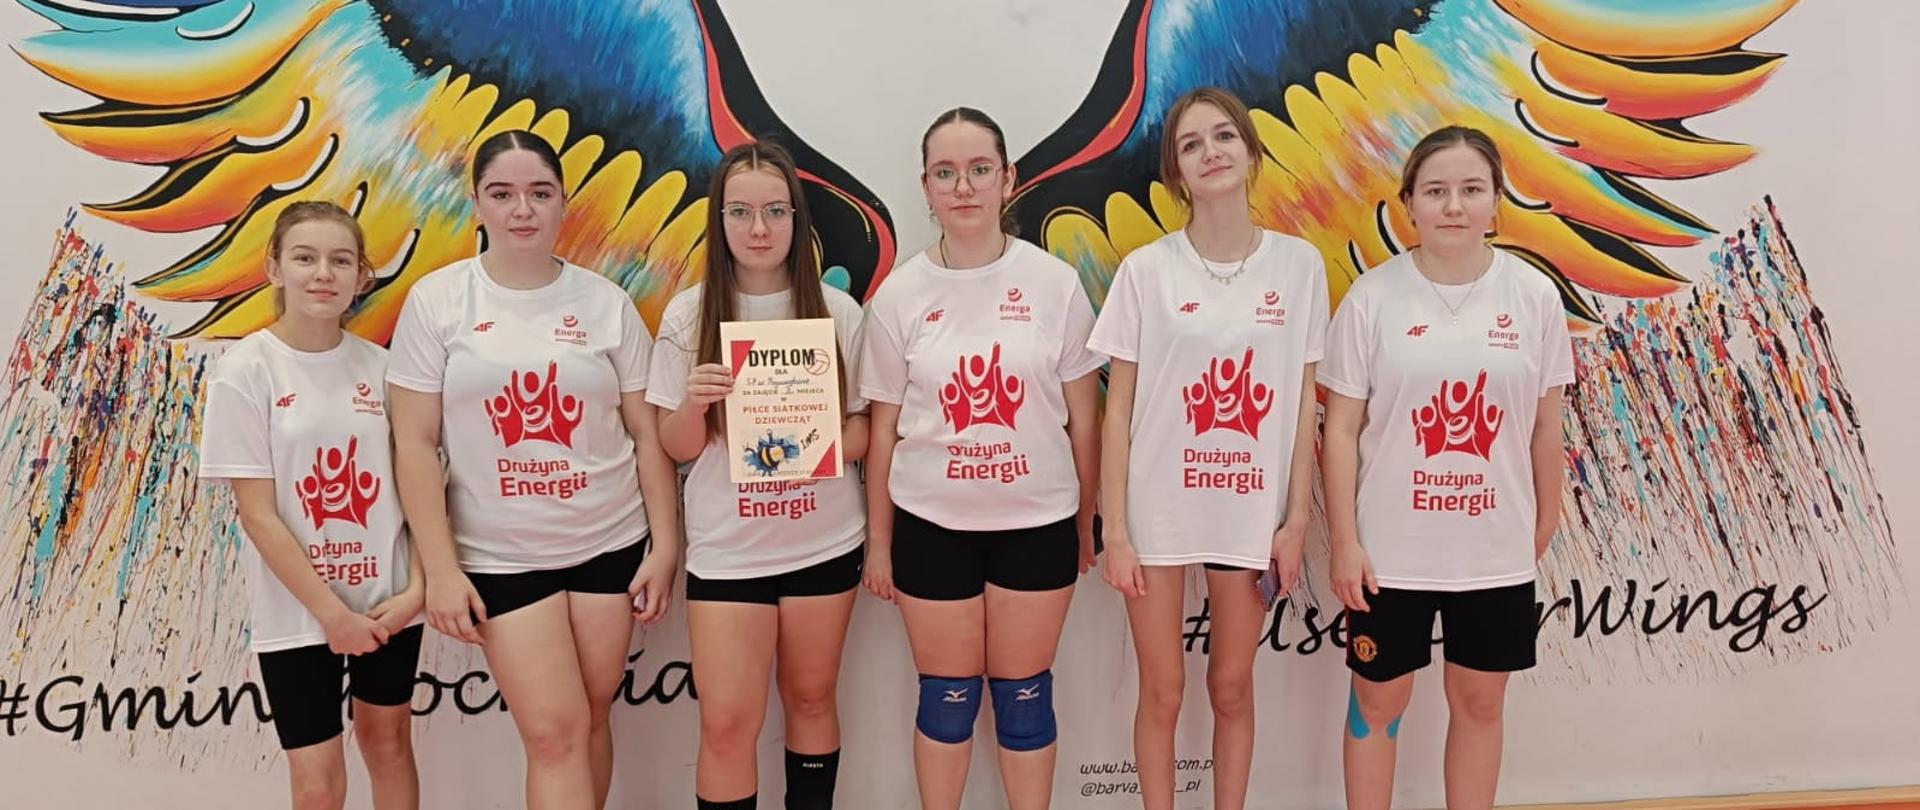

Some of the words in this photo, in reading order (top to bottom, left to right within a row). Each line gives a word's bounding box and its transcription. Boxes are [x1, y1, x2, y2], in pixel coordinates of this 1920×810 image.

[926, 309, 944, 322] 4F
[1000, 304, 1030, 313] Energa
[1180, 303, 1199, 313] 4F
[473, 322, 495, 332] 4F
[1407, 325, 1429, 336] 4F
[748, 348, 815, 367] DYPLOM
[276, 394, 296, 407] 4F
[743, 405, 770, 413] PIŁCE
[773, 404, 828, 412] SIATKOWEJ
[755, 416, 811, 424] DZIEWCZĄT
[947, 442, 1011, 460] Drużyna
[1184, 448, 1251, 467] Drużyna
[497, 458, 570, 477] Drużyna
[946, 454, 1031, 484] Energii
[500, 471, 588, 499] Energii
[1184, 468, 1264, 494] Energii
[1413, 470, 1484, 490] Drużyna
[738, 491, 816, 520] Energii
[1413, 488, 1496, 516] Energii
